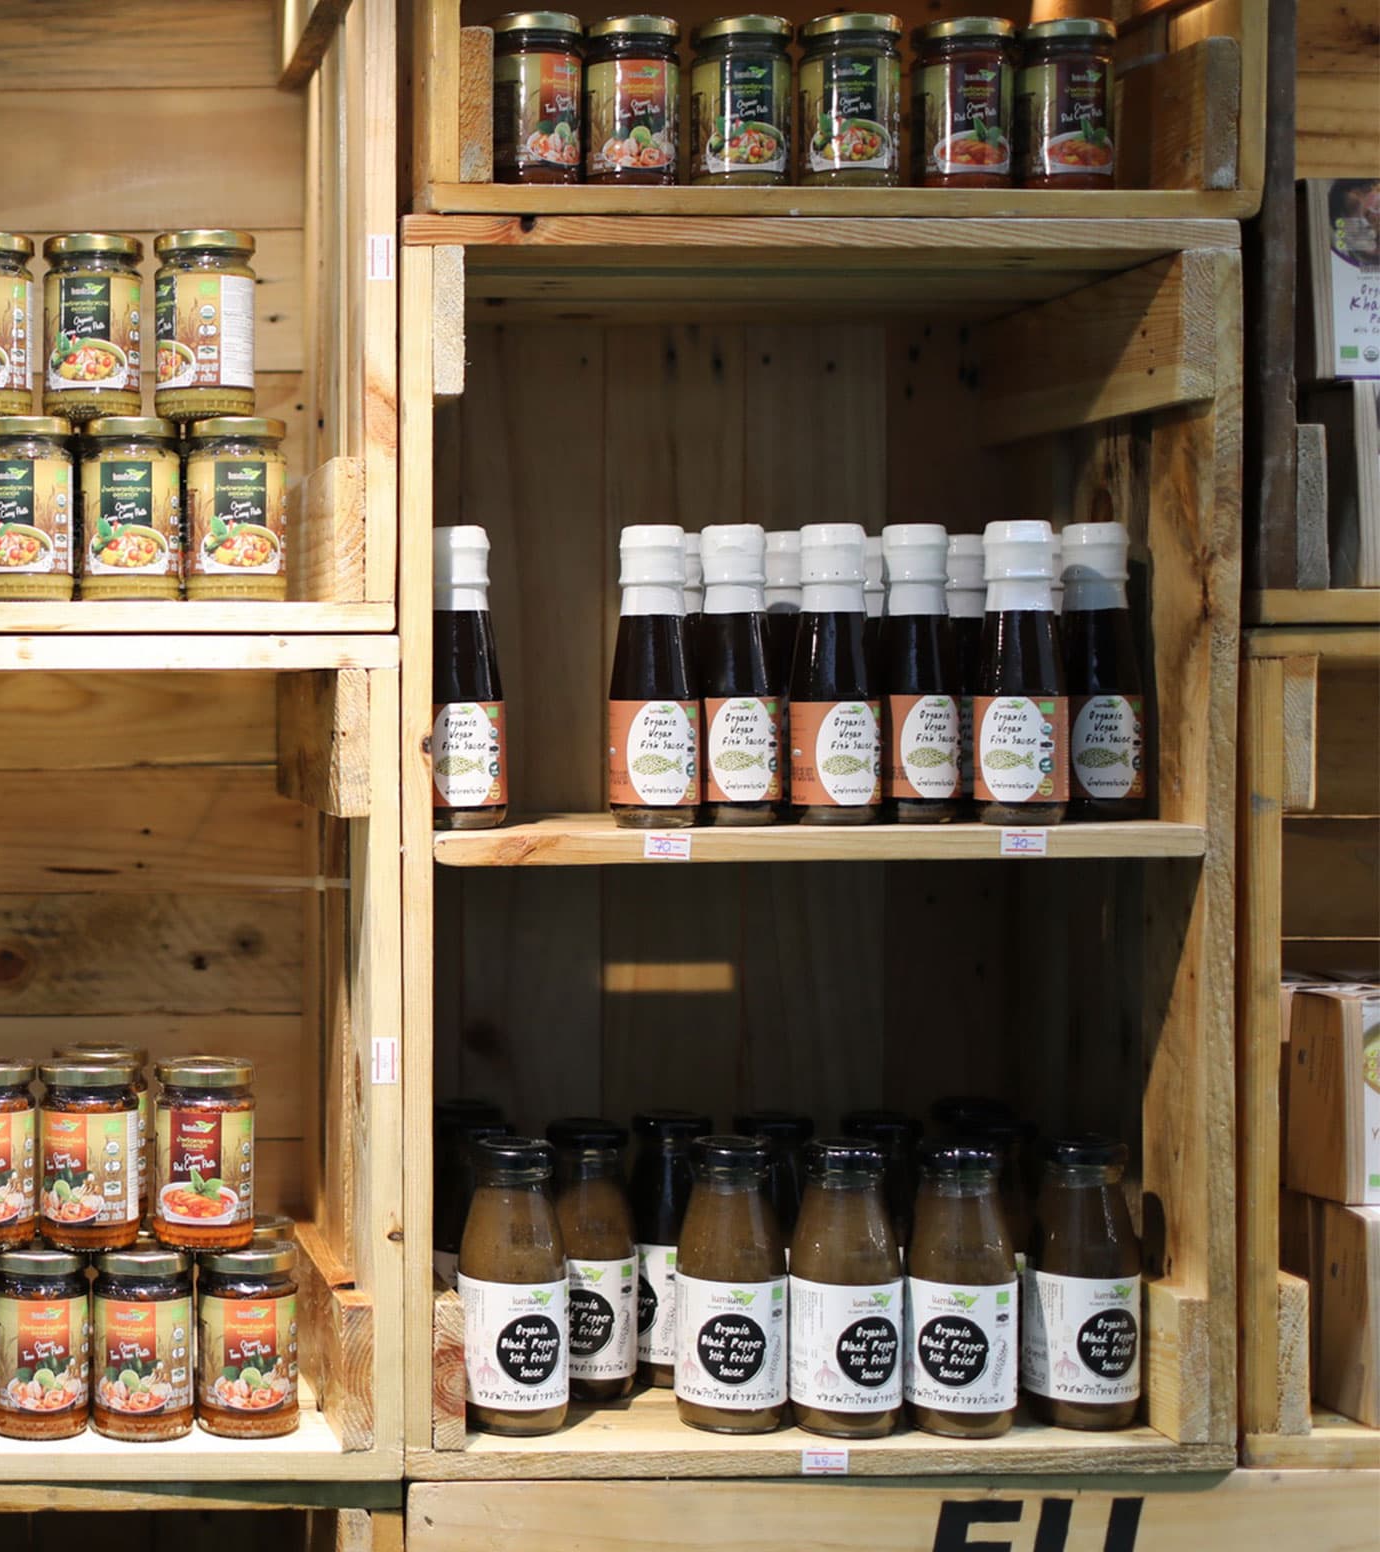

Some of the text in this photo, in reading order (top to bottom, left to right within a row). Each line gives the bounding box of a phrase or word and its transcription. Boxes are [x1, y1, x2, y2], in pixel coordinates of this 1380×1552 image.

[725, 712, 758, 725] Organic
[920, 711, 950, 721] Organic
[993, 711, 1027, 722] Organic
[1089, 711, 1123, 722] Organic
[644, 718, 677, 732] Organic
[834, 717, 865, 729] Organic
[924, 721, 946, 732] Vegan
[998, 723, 1022, 733] Vegan
[1094, 722, 1118, 732] Vegan
[649, 729, 672, 738] Vegan
[730, 725, 754, 734] Vegan
[839, 730, 861, 738] Vegan
[575, 1314, 611, 1327] Pepper
[516, 1324, 548, 1337] Organic
[714, 1323, 750, 1336] Organic
[856, 1327, 888, 1339] Organic
[934, 1323, 971, 1338] Organic
[531, 1338, 557, 1351] Pepper
[734, 1339, 762, 1351] Pepper
[871, 1340, 898, 1352] Pepper
[951, 1339, 984, 1352] Pepper
[530, 1351, 552, 1363] Fried
[729, 1351, 754, 1363] Fried
[871, 1353, 891, 1366] Fried
[950, 1353, 975, 1365] Fried
[520, 1366, 544, 1378] Sauce
[719, 1366, 744, 1378] Sauce
[940, 1367, 964, 1379] Sauce
